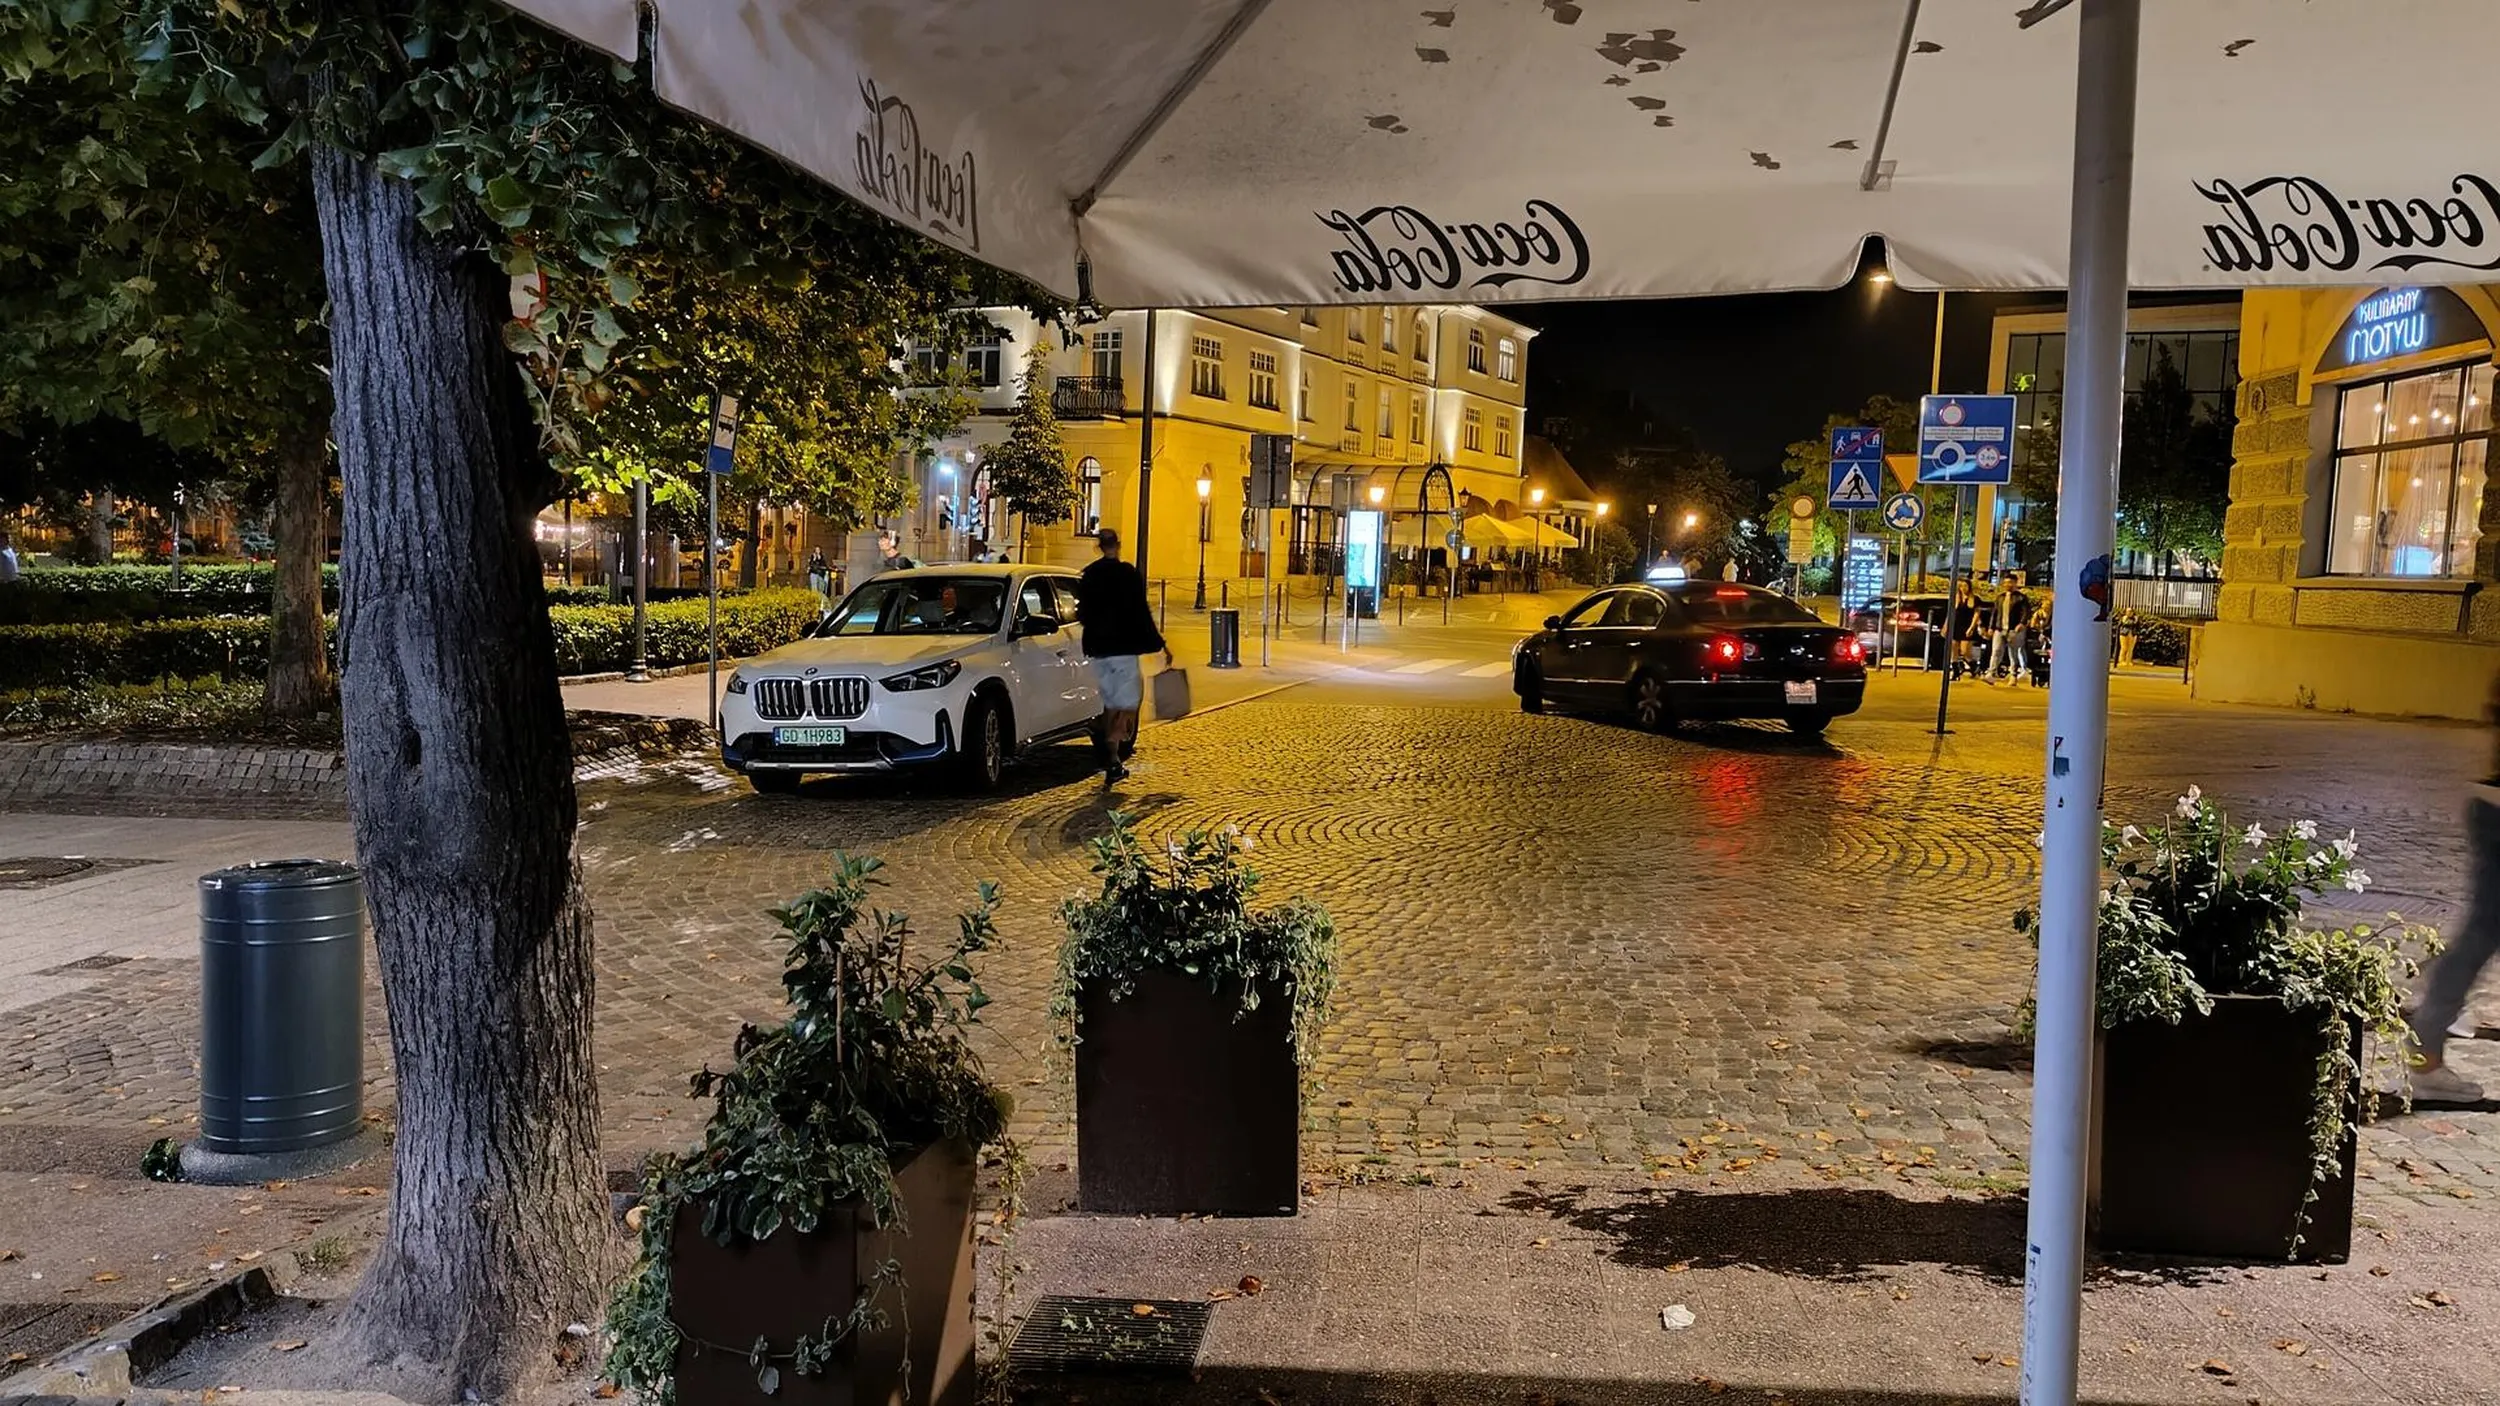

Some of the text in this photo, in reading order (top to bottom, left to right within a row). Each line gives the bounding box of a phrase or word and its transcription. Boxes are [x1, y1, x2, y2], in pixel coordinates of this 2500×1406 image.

[2359, 289, 2420, 324] KULINARNY
[2350, 313, 2425, 362] MOTYW
[782, 729, 841, 742] GD 1H983
